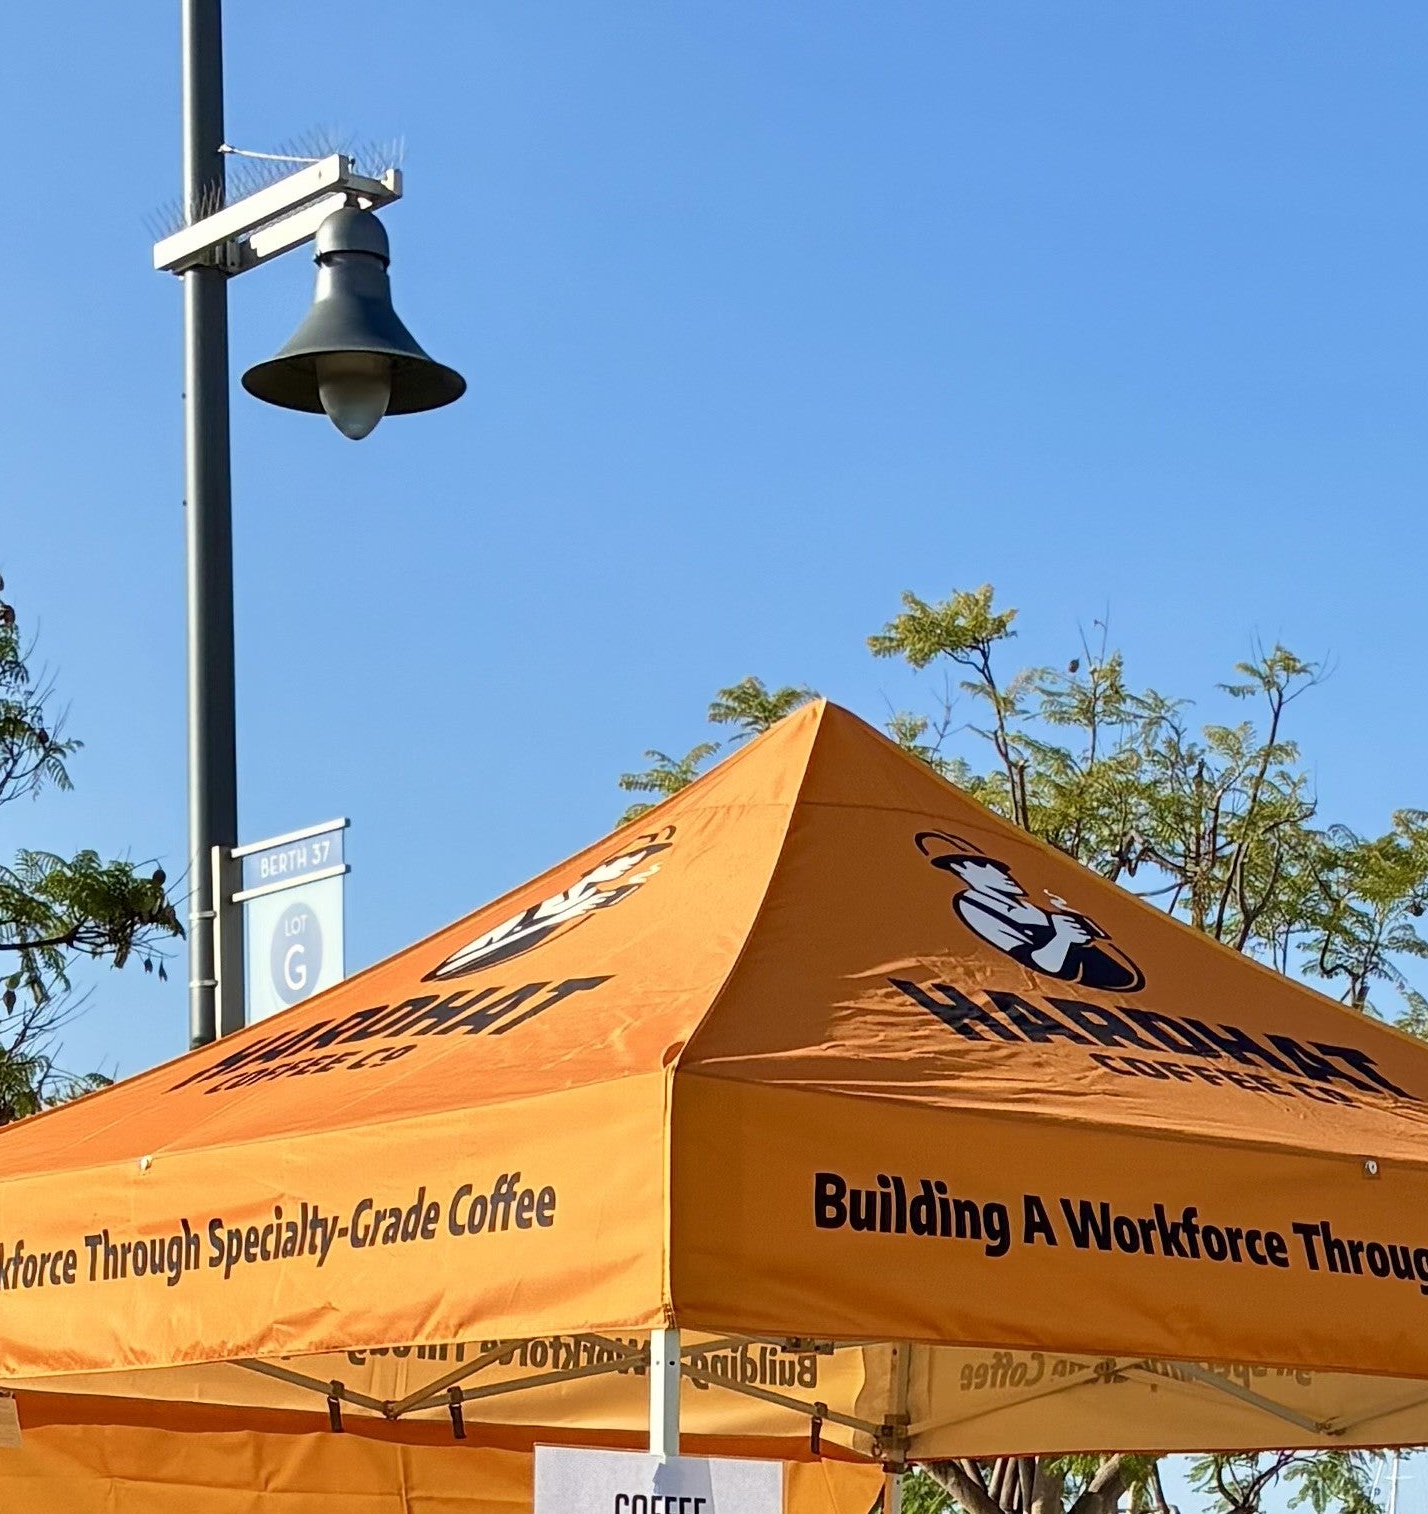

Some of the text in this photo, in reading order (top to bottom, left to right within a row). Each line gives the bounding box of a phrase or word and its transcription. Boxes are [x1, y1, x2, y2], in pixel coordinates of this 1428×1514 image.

[260, 840, 331, 878] BERTH 37
[285, 914, 308, 937] LOT
[284, 944, 307, 991] G
[160, 974, 617, 1094] HARDHAT
[888, 977, 1422, 1101] HARDHAT
[204, 1050, 362, 1095] COFFEE
[1089, 1052, 1294, 1098] COFFEE
[85, 1218, 200, 1286] Through
[208, 1186, 440, 1280] Specialty-Grade
[448, 1171, 557, 1237] Coffee
[814, 1172, 1010, 1257] Building
[1023, 1194, 1059, 1247] A
[1060, 1197, 1290, 1268] Workforce
